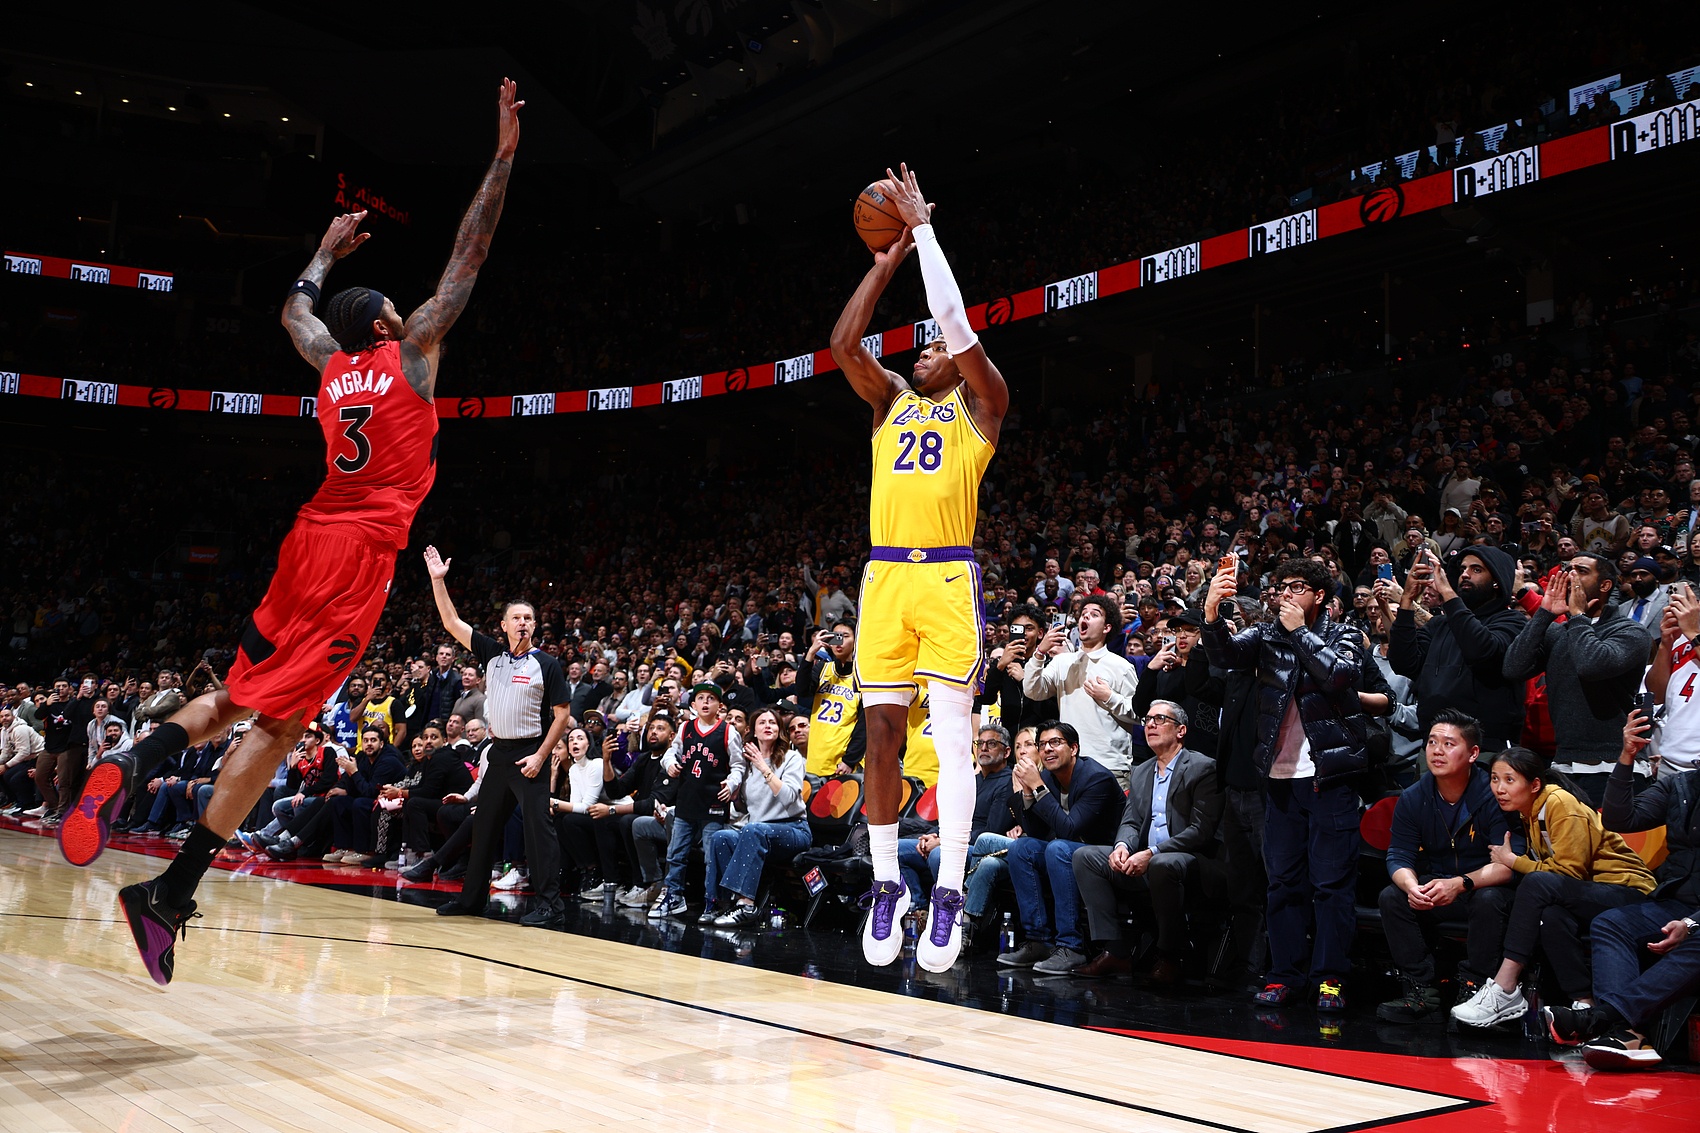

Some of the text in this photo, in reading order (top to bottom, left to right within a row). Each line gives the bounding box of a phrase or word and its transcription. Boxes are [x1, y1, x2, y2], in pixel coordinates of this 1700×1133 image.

[326, 369, 394, 404] INGRAM
[333, 405, 373, 473] 3
[892, 430, 943, 473] 28
[1679, 673, 1698, 702] 4
[818, 698, 844, 724] 23
[682, 743, 719, 767] RAPTORS
[692, 760, 701, 778] 4
